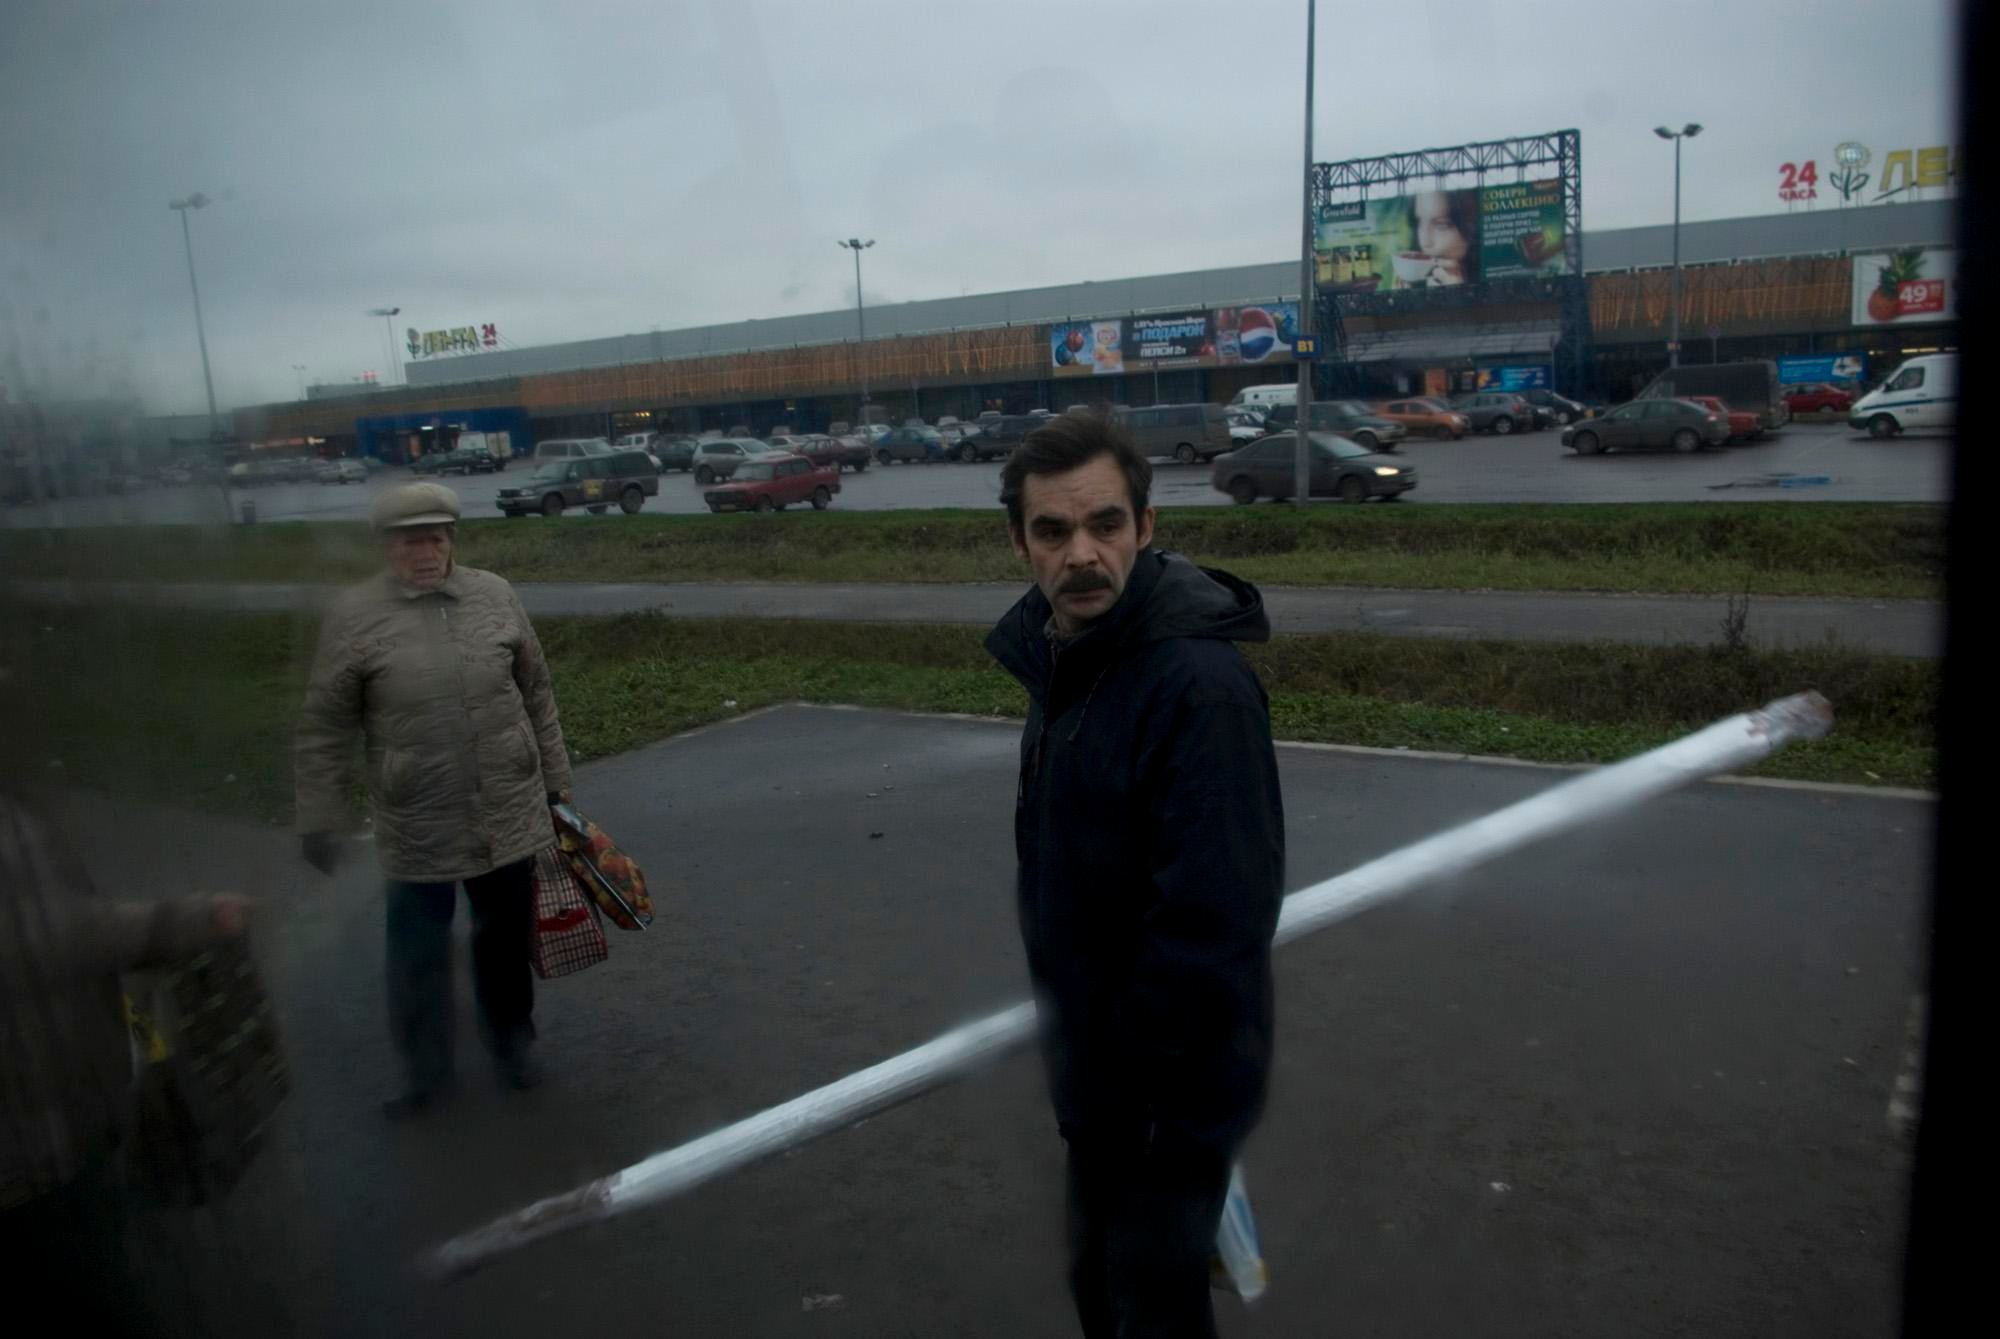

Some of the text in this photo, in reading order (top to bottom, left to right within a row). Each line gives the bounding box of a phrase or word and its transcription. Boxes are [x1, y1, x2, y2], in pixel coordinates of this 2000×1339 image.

[1779, 160, 1818, 189] 24
[1482, 193, 1560, 211] КОЛЛЕКЦИЮ
[1483, 187, 1526, 201] СОБЕРИ
[1779, 188, 1817, 202] ЧАСА
[1899, 284, 1928, 304] 49
[1142, 324, 1206, 342] ПОДАРОК
[1140, 346, 1173, 358] ПЕПСИ
[1297, 339, 1314, 353] B1
